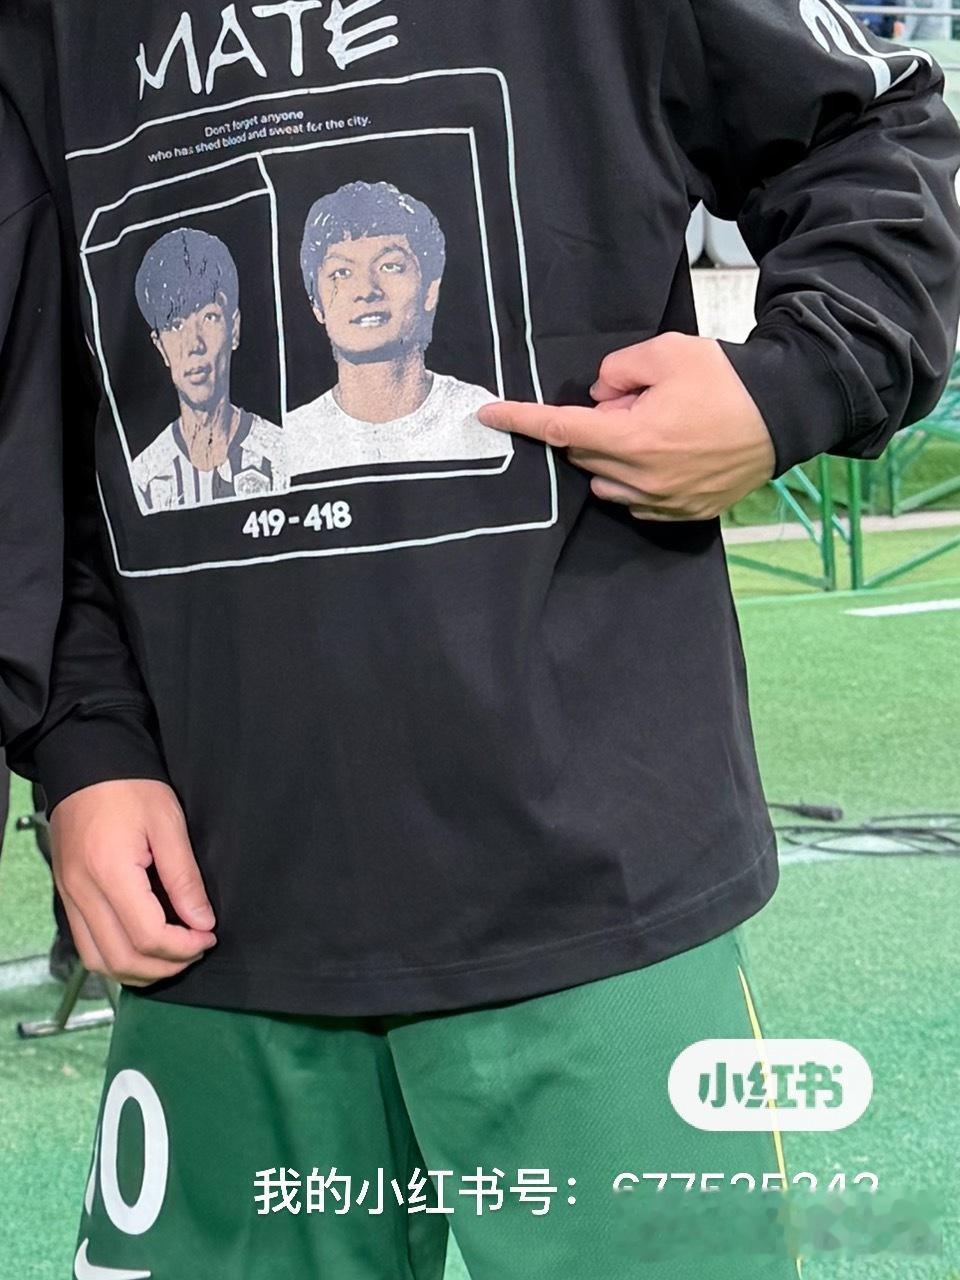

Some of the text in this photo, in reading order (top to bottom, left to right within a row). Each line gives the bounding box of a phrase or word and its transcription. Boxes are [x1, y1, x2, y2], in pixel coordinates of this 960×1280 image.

[260, 110, 304, 124] anyone
[147, 150, 173, 163] who
[173, 145, 194, 158] has
[195, 137, 222, 154] shed
[222, 131, 247, 148] blood
[268, 123, 304, 137] sweat
[306, 121, 324, 133] for
[325, 119, 345, 131] the
[346, 115, 372, 127] city.
[242, 500, 353, 538] 419-418
